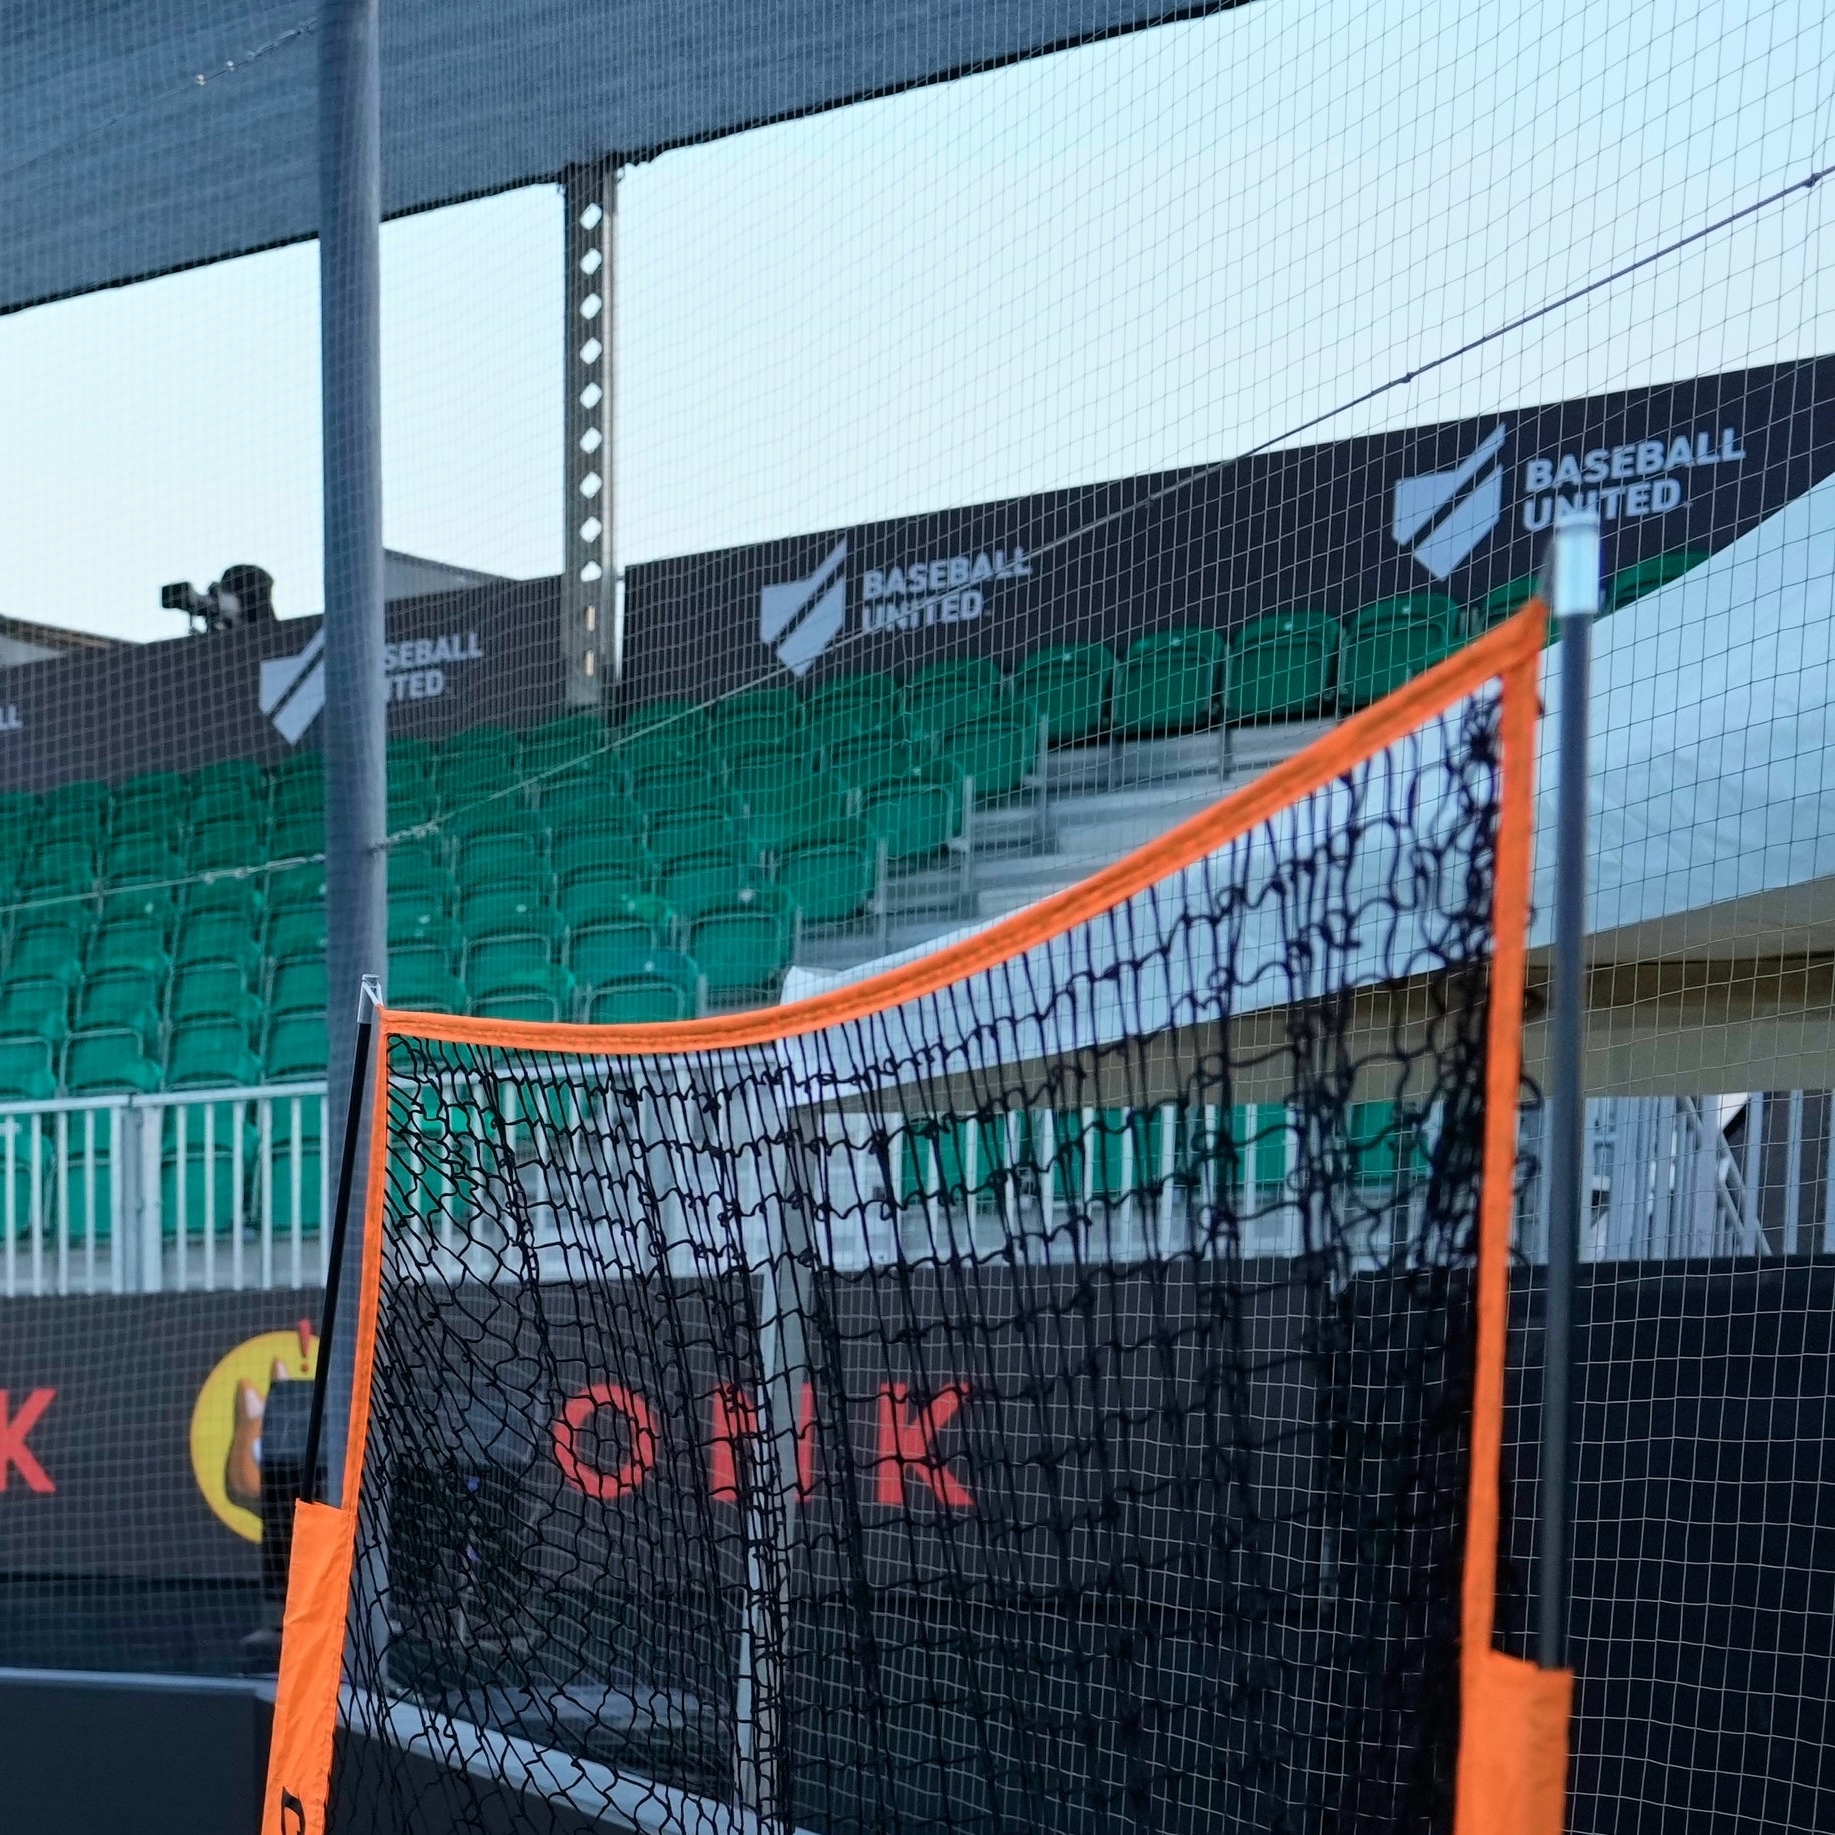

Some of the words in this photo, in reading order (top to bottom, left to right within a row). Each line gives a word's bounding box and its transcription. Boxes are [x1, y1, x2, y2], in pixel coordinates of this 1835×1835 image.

[1525, 427, 1745, 492] BASEBALL
[1524, 478, 1680, 531] UNITED
[861, 545, 1032, 599] BASEBALL
[861, 591, 983, 634] UNITED
